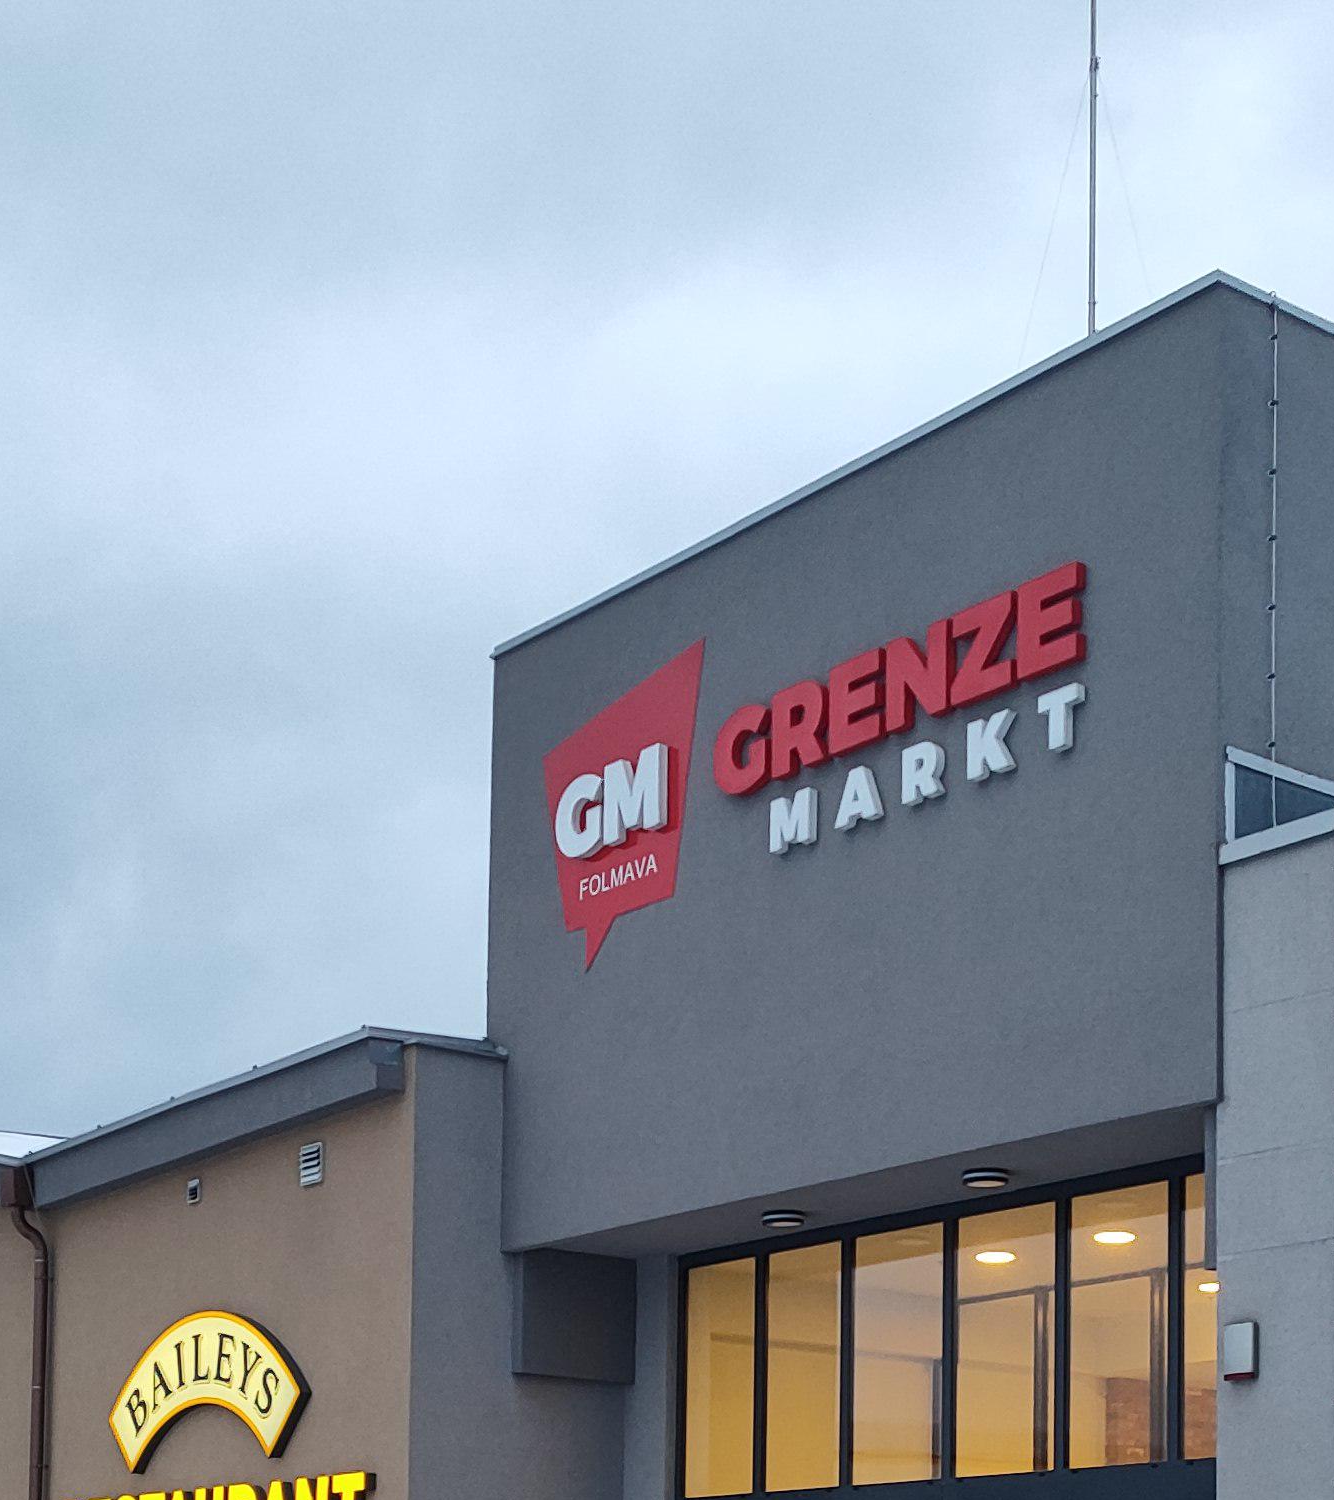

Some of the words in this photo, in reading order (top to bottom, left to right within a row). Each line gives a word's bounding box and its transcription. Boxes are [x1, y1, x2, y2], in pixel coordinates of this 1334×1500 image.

[712, 560, 1086, 796] GRENZE
[554, 743, 669, 859] GM
[769, 682, 1086, 854] MARKT
[578, 853, 658, 900] FOLMAVA
[124, 1332, 280, 1436] BAILEYS
